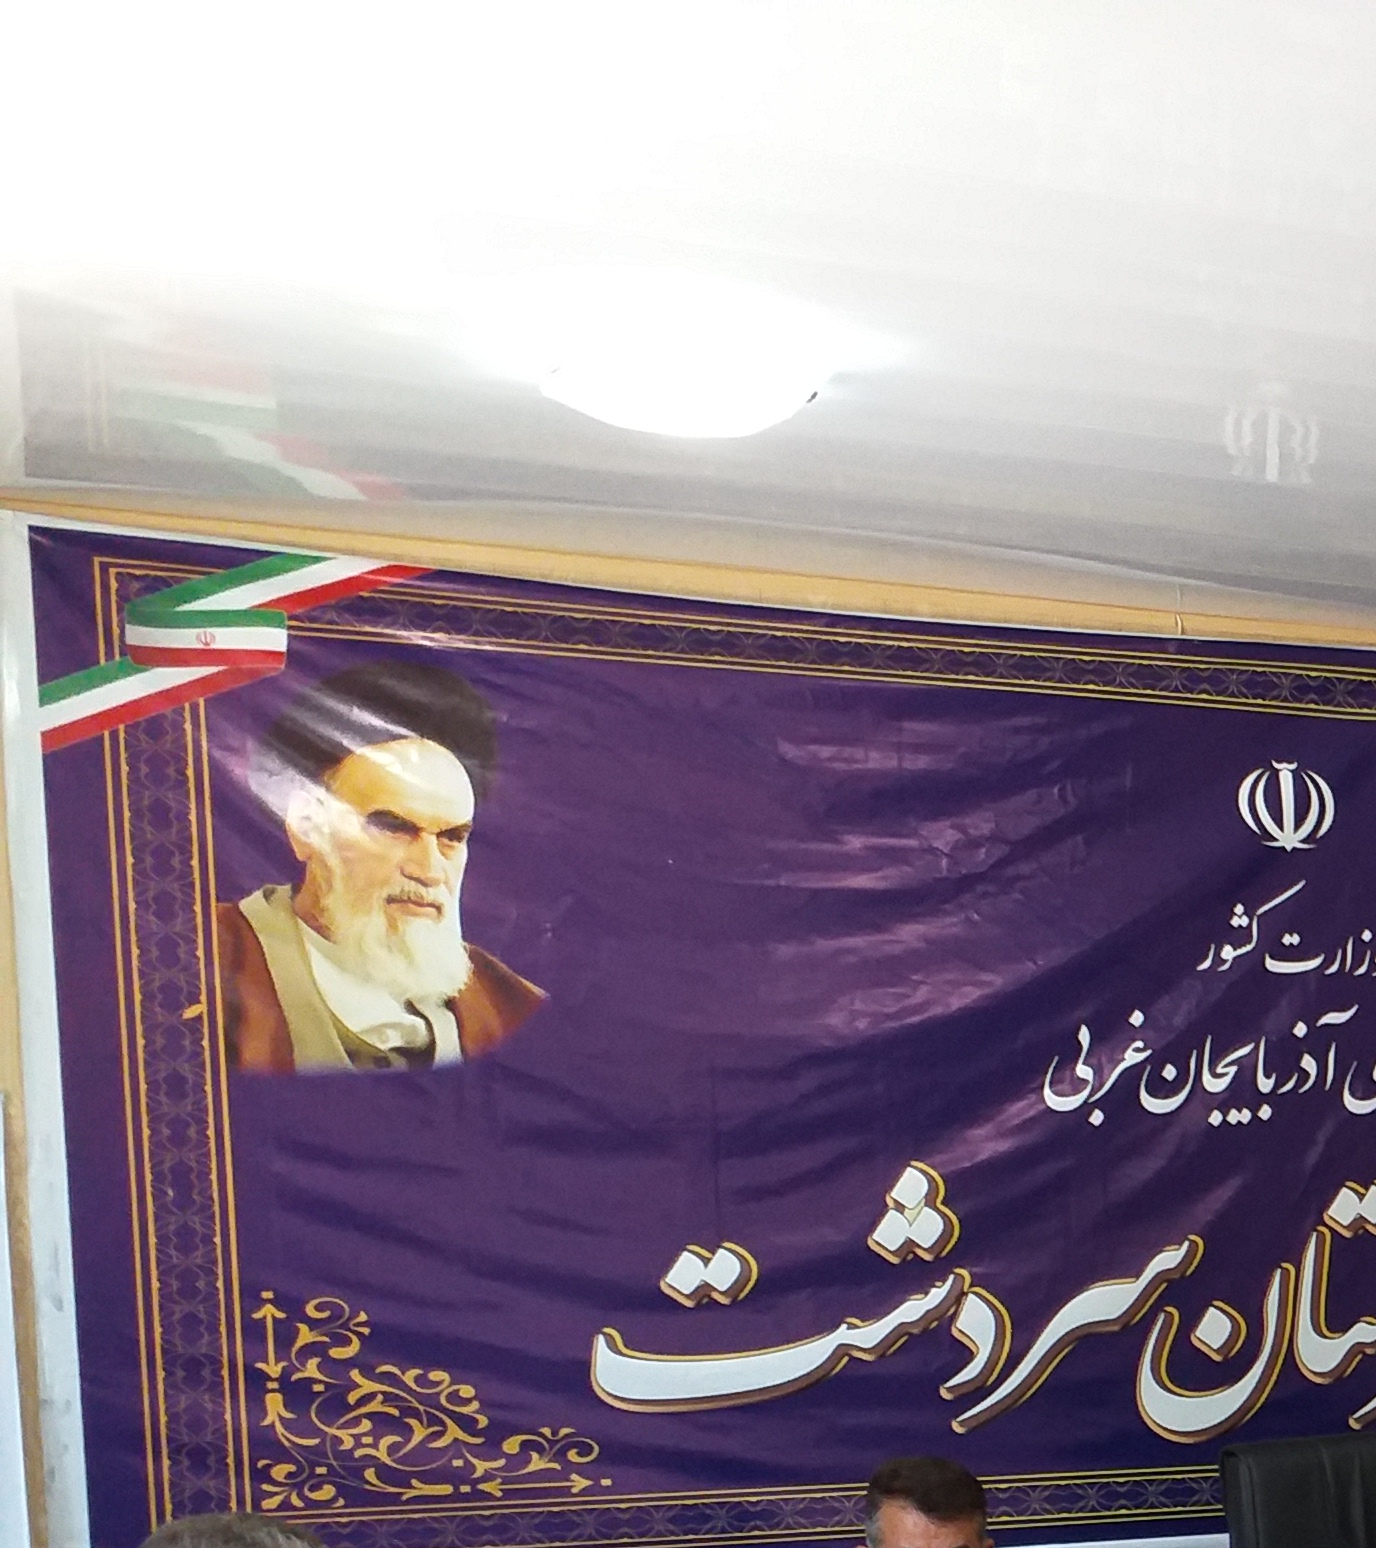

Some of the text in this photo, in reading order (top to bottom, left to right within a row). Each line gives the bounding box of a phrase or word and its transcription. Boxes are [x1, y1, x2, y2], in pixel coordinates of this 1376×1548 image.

[1196, 879, 1307, 973] کشور
[1041, 1008, 1154, 1127] غربی
[1138, 1003, 1360, 1127] آذربایجان
[590, 1159, 1206, 1436] سردشت
